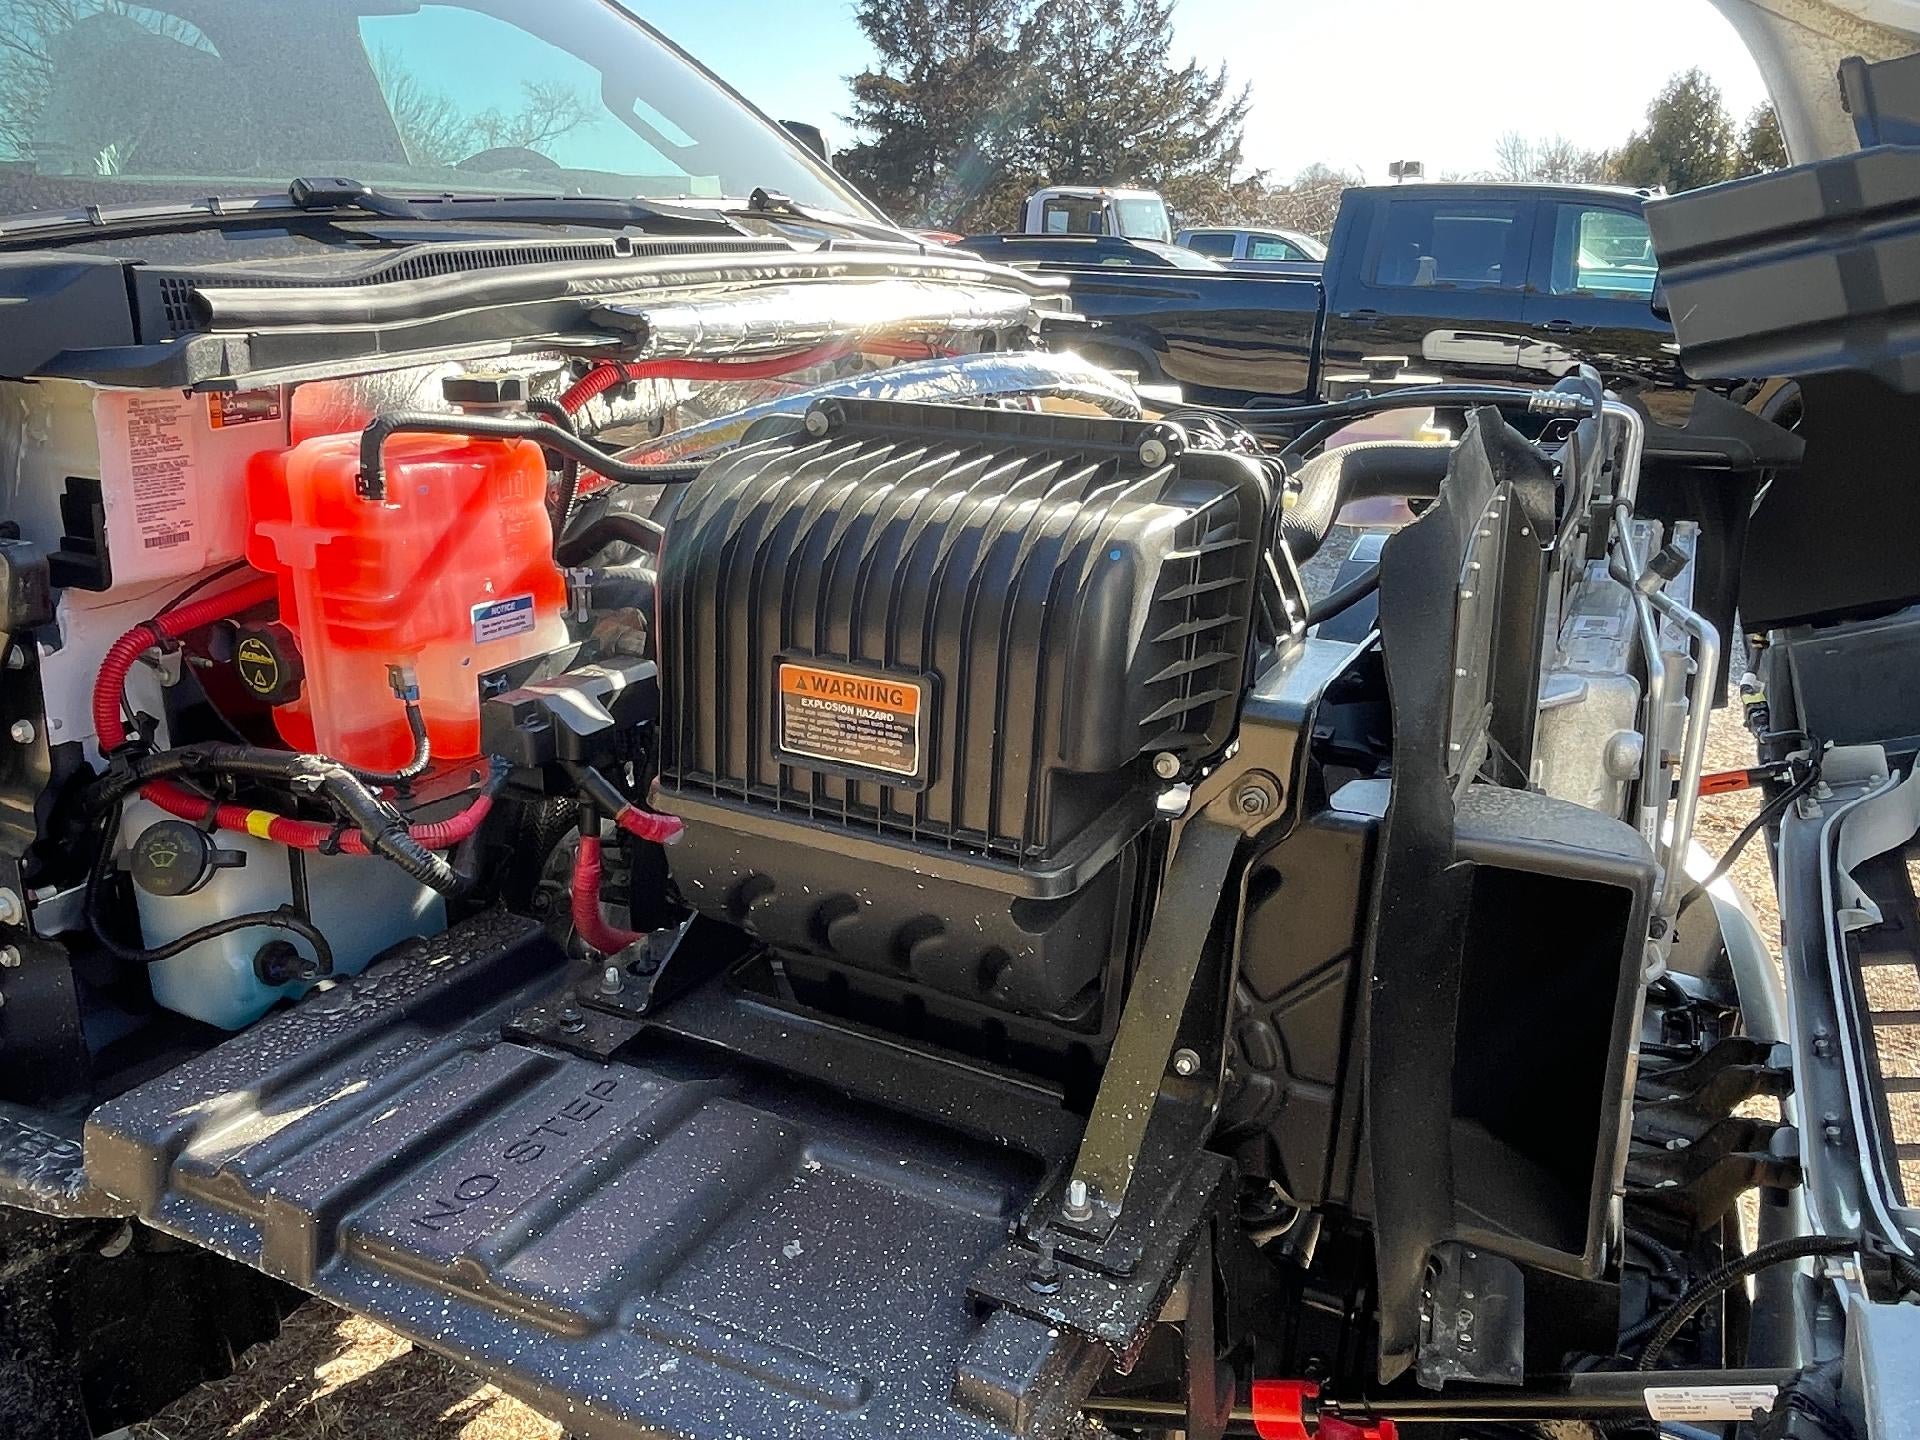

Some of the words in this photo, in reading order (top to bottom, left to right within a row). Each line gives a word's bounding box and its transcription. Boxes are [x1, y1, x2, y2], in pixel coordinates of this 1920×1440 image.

[490, 601, 517, 616] NOTICE
[811, 675, 903, 707] WARNING
[801, 697, 855, 715] EXPLOSION
[855, 707, 895, 722] HAZARD
[409, 1174, 501, 1231] NO
[502, 1079, 618, 1165] STEP
